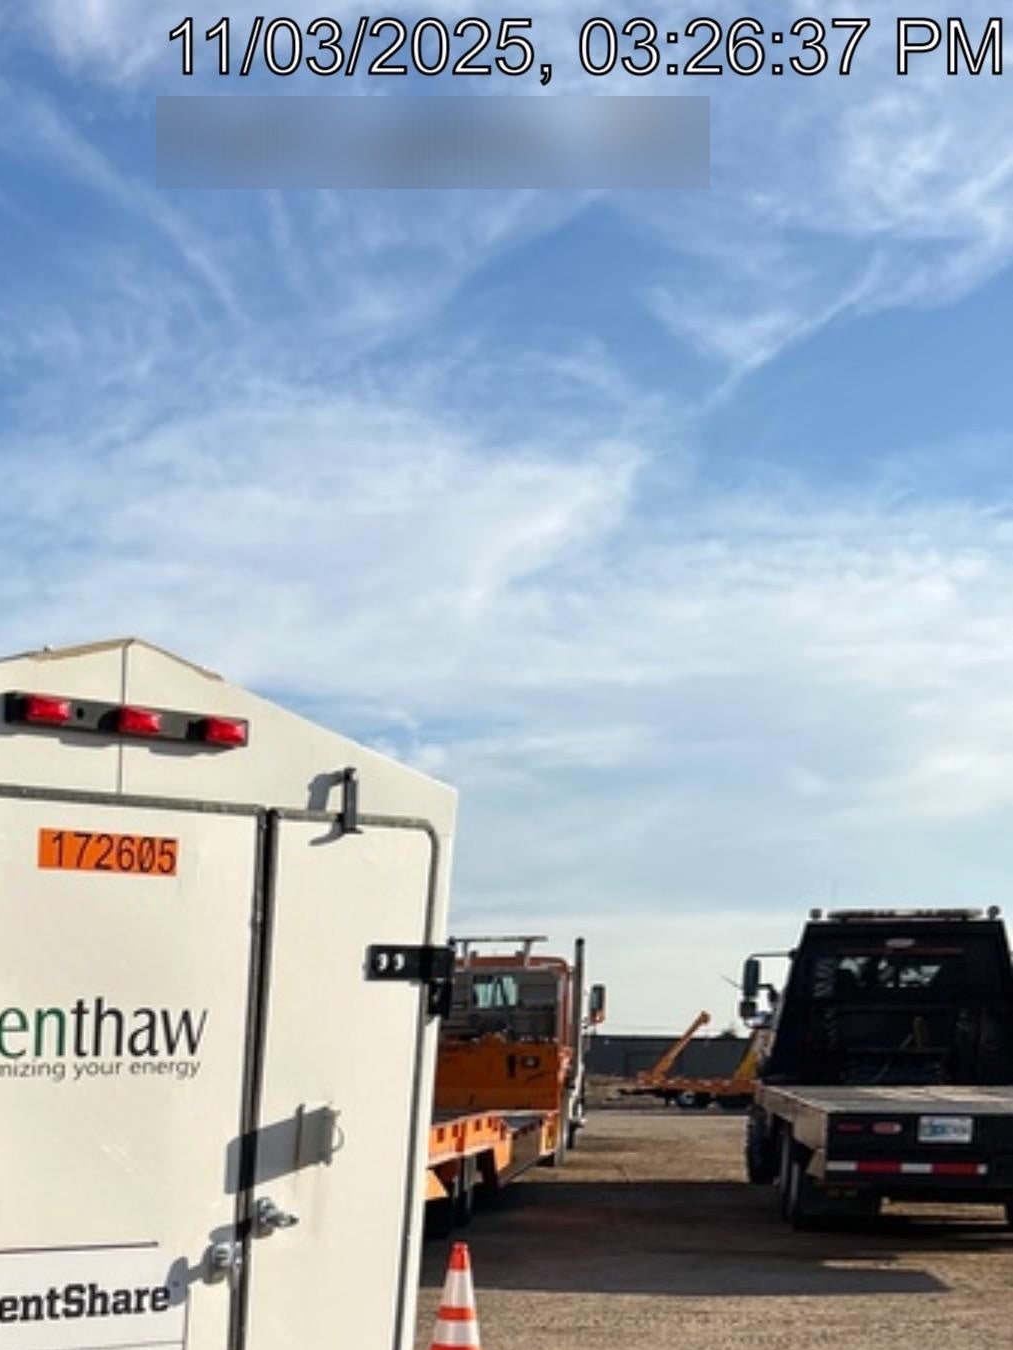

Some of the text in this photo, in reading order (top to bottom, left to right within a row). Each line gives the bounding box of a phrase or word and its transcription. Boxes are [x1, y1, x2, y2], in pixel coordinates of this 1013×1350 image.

[52, 830, 177, 874] 172605
[72, 1060, 124, 1082] your
[129, 1059, 202, 1082] energy
